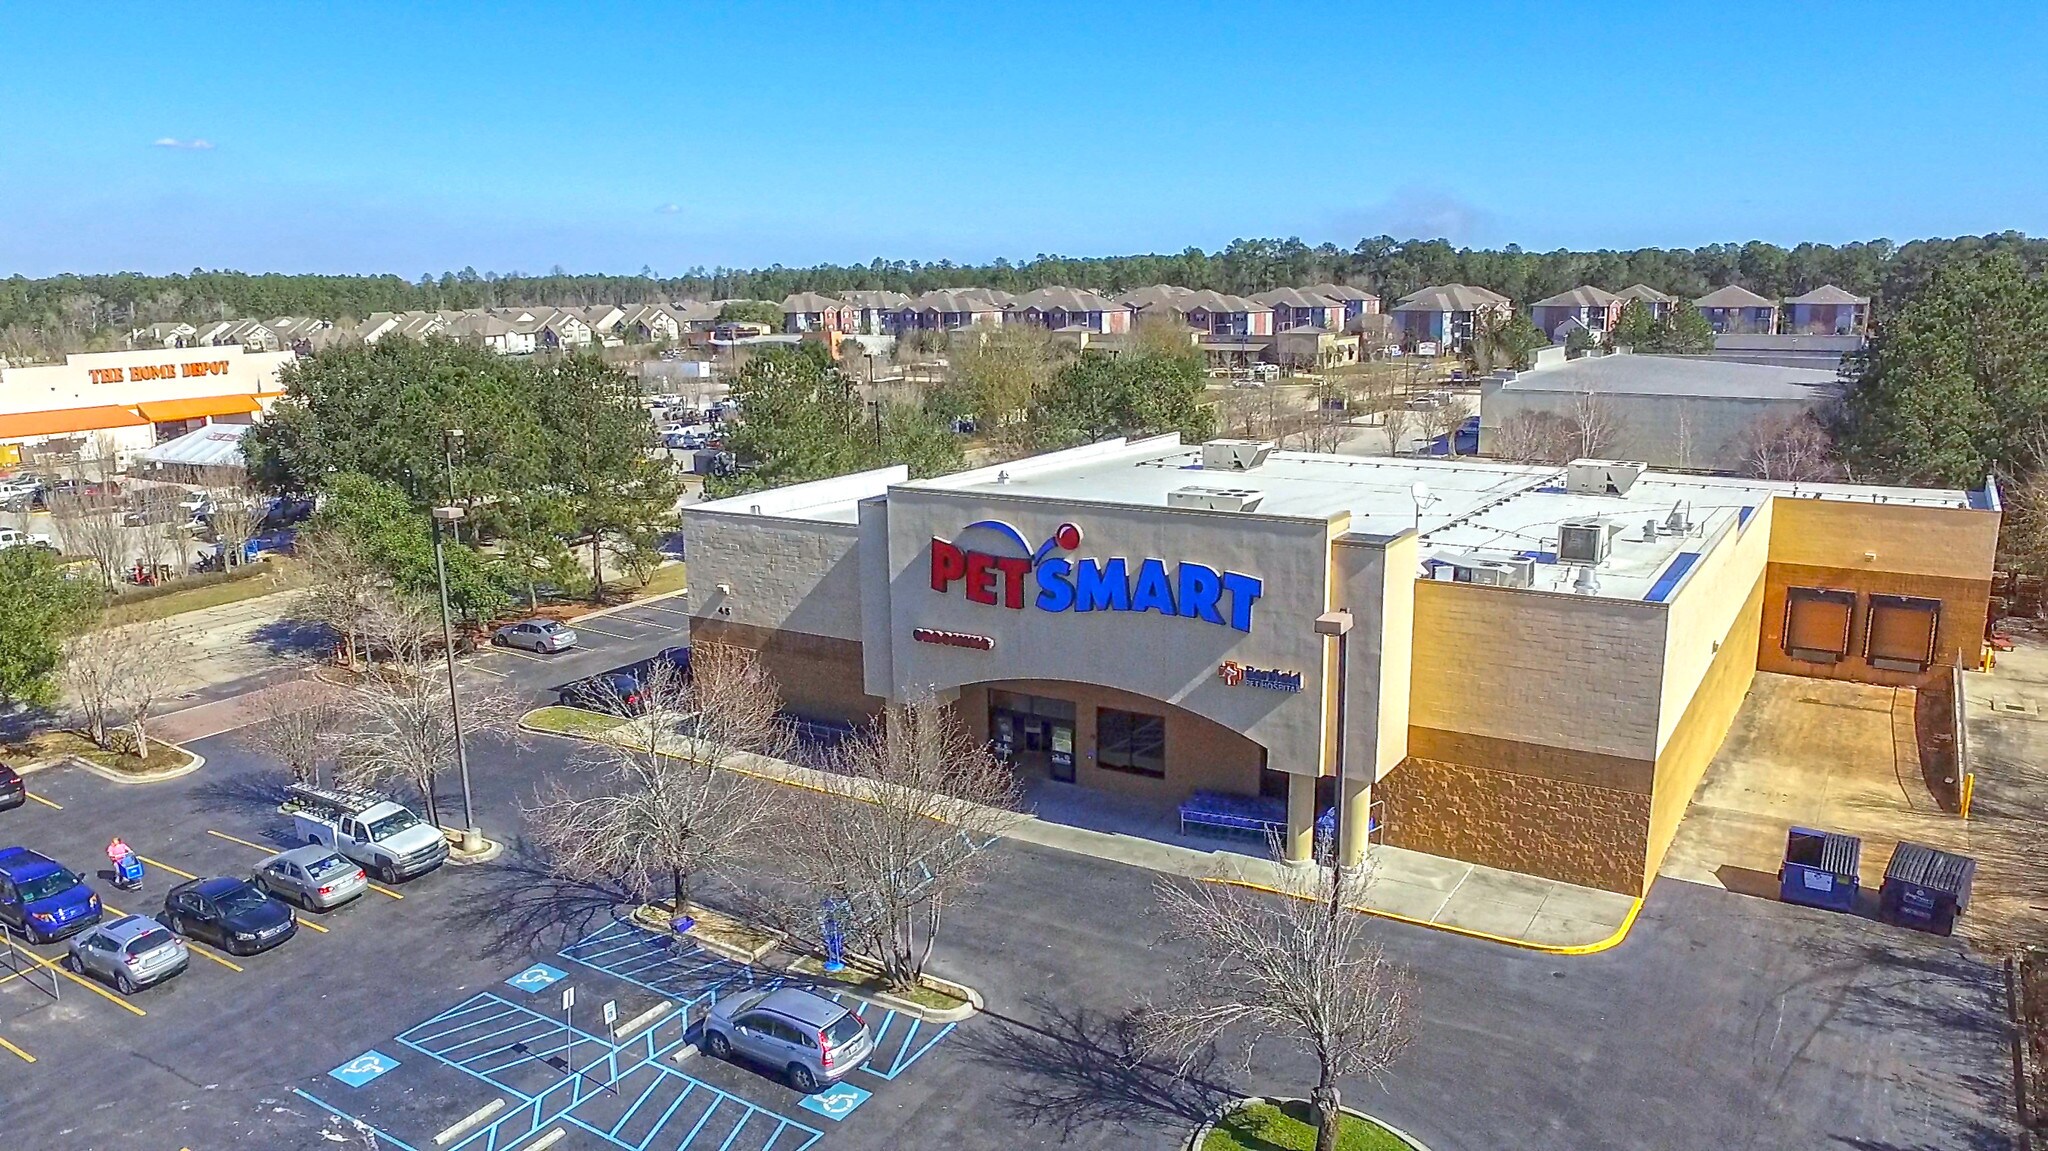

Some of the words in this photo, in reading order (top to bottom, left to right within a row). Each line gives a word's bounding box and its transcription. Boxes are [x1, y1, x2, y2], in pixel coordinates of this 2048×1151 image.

[88, 368, 124, 384] THE
[129, 364, 176, 382] HOME
[181, 360, 229, 378] DEPOT
